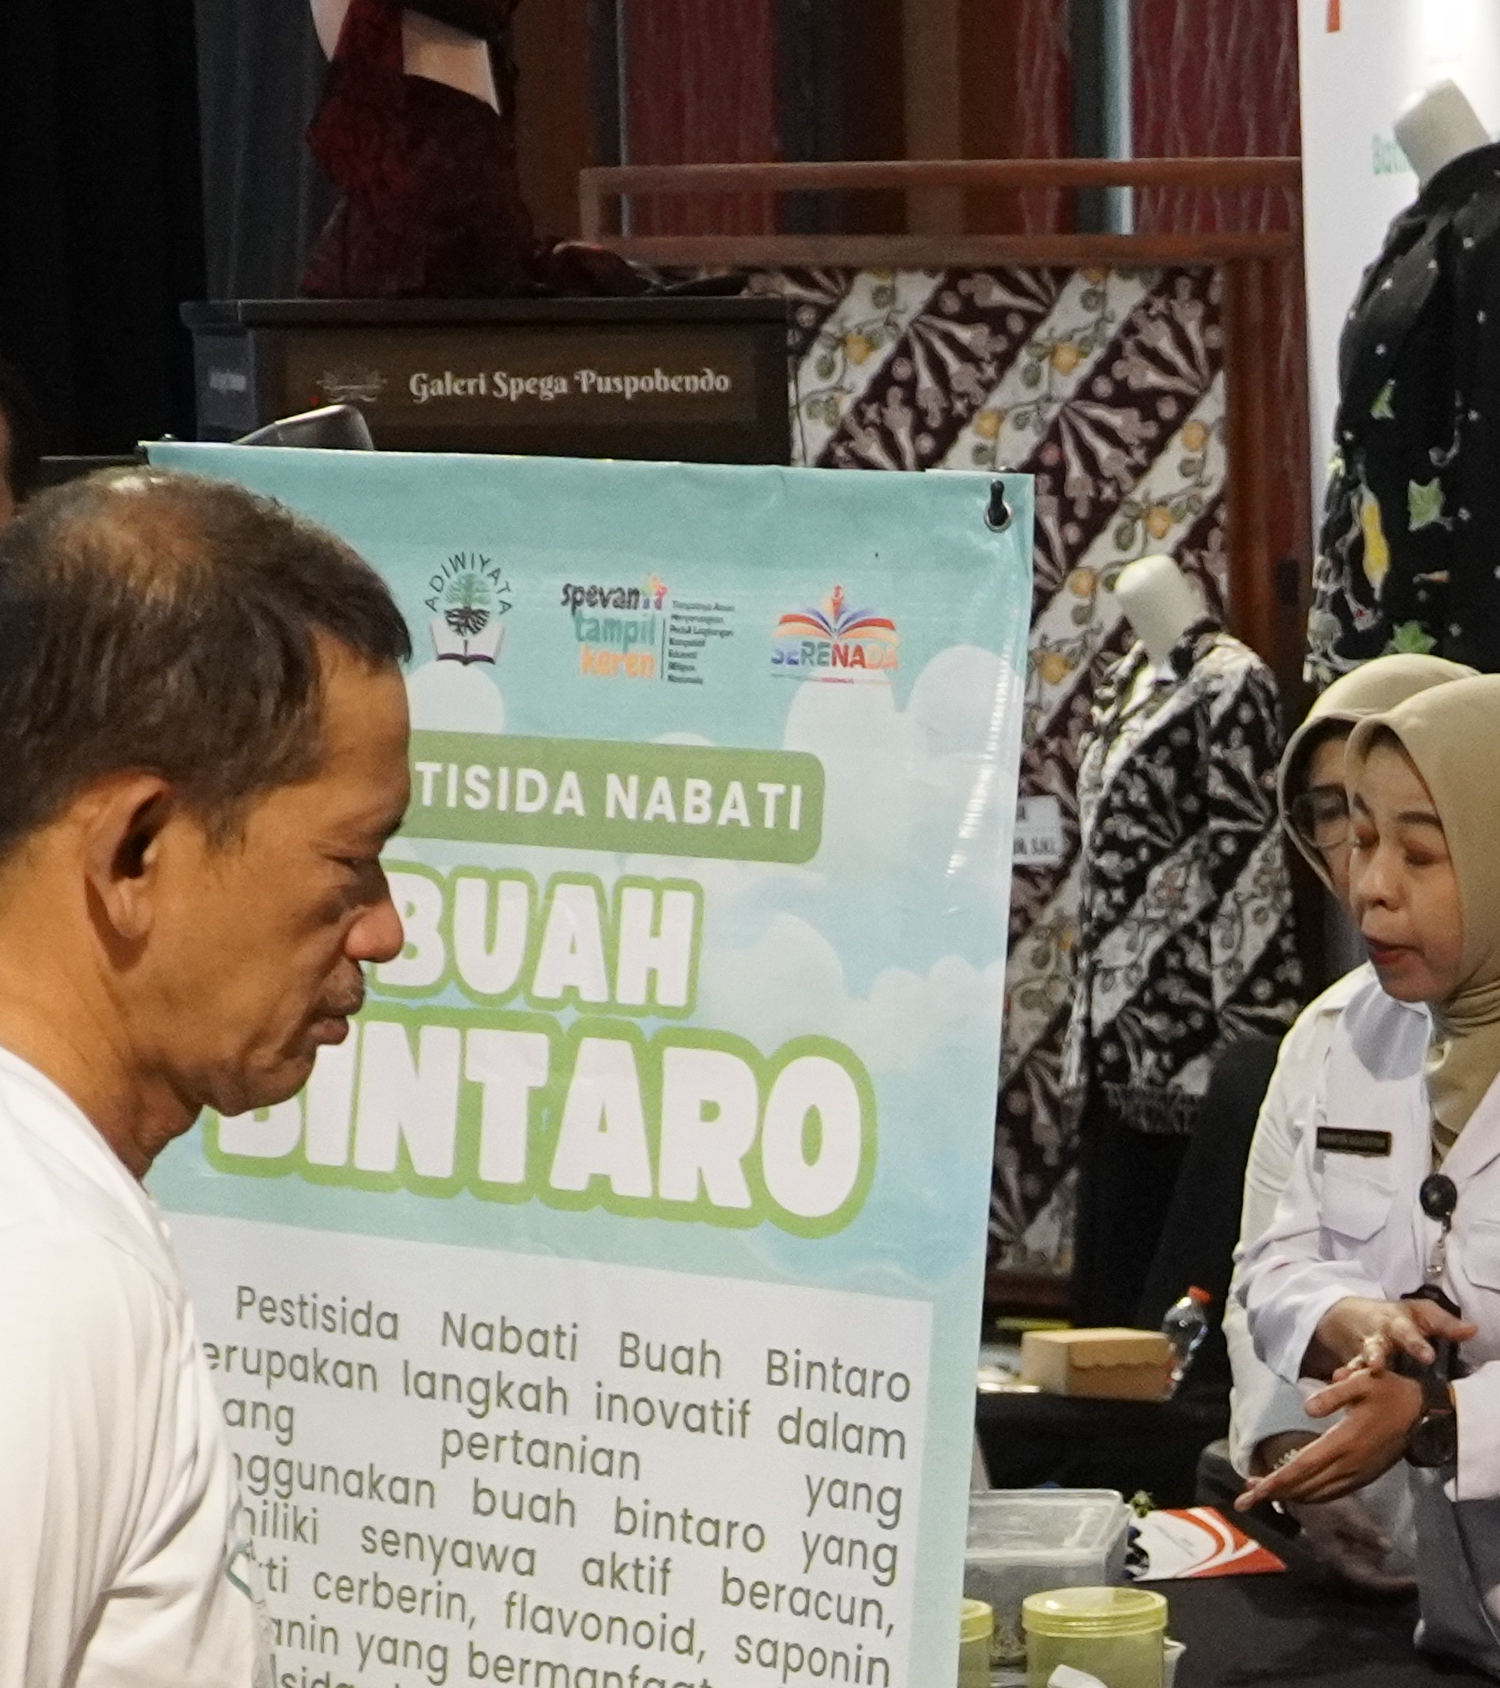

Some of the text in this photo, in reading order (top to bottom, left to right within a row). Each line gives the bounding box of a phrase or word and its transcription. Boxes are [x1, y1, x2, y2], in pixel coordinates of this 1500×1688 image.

[408, 366, 732, 403] Galeri Spega Puspobendo
[424, 551, 514, 616] ADIWIYATA
[573, 609, 657, 655] tampil
[580, 642, 656, 678] keren
[414, 761, 803, 831] TISIDA NABATI
[376, 870, 696, 1009] BUAH
[235, 1285, 911, 1403] Pestisida Nabati Buah Bintaro
[202, 1341, 907, 1460] erupakan langkah inovatif dalam
[222, 1398, 902, 1531] ang pertanian yang
[360, 1524, 536, 1577] senyawa
[581, 1551, 672, 1596] aktif
[721, 1566, 895, 1638] beracun,
[472, 1477, 576, 1528] buah
[614, 1495, 766, 1553] bintaro
[801, 1530, 898, 1587] yang
[313, 1570, 476, 1631] cerberin,
[505, 1590, 706, 1665] flavonoid,
[734, 1633, 890, 1688] saponin
[356, 1631, 449, 1687] yang
